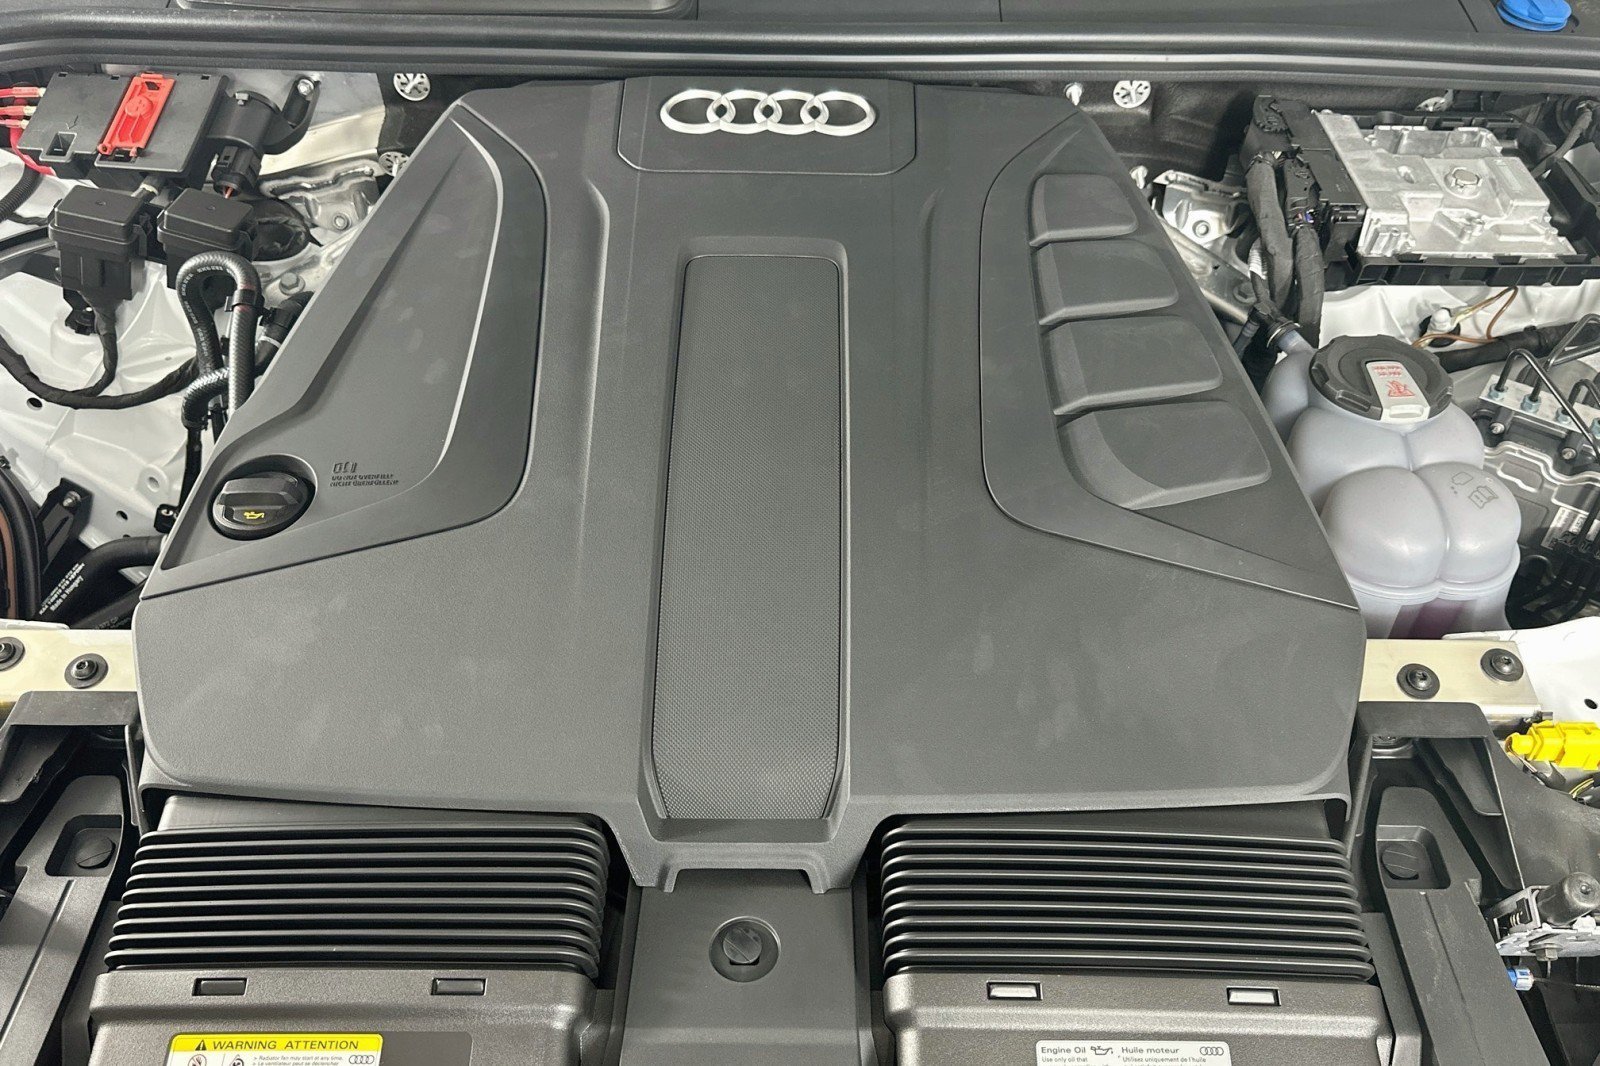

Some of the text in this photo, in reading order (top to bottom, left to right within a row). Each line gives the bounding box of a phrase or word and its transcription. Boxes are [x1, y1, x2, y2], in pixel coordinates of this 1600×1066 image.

[212, 1040, 359, 1050] WARNING ATTENTION
[1041, 1046, 1087, 1055] Engine Oil
[1121, 1046, 1144, 1054] Huile
[1144, 1056, 1179, 1064] uniquement
